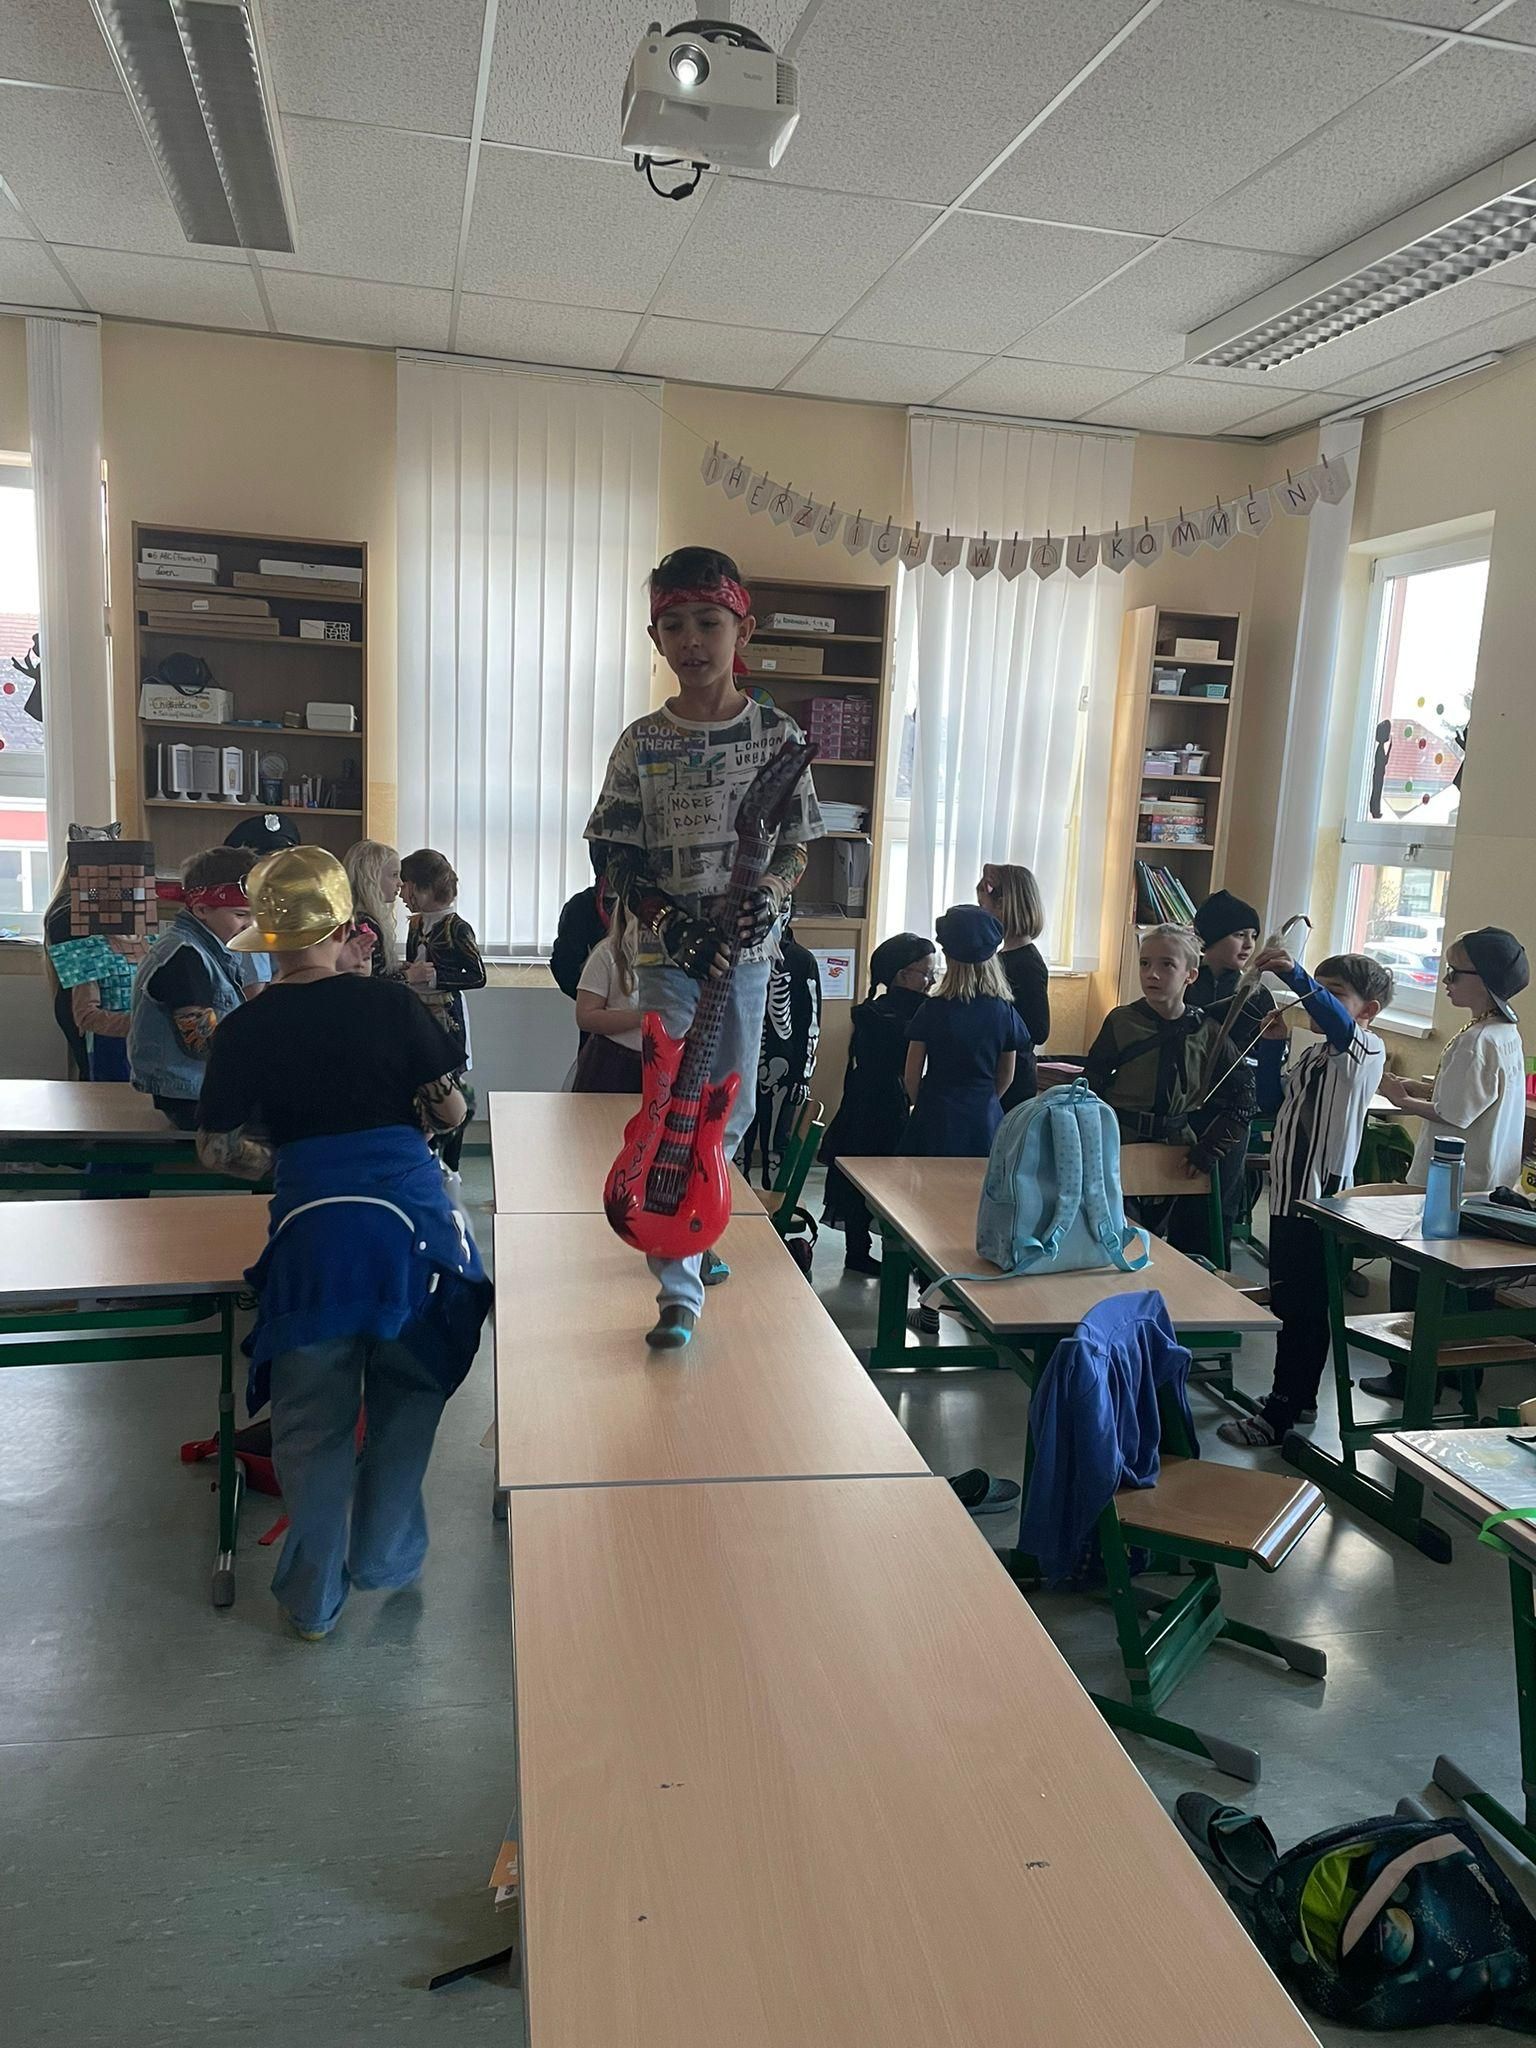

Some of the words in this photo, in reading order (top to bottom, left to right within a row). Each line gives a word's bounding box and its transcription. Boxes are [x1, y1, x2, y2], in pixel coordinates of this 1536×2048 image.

[729, 471, 921, 557] HERZLICH
[974, 484, 1307, 568] WILLKOMMEN
[636, 724, 681, 738] LOOK
[637, 737, 681, 751] THERE
[735, 736, 783, 752] LONDON
[736, 751, 774, 766] URBAN
[674, 814, 717, 829] ROCK
